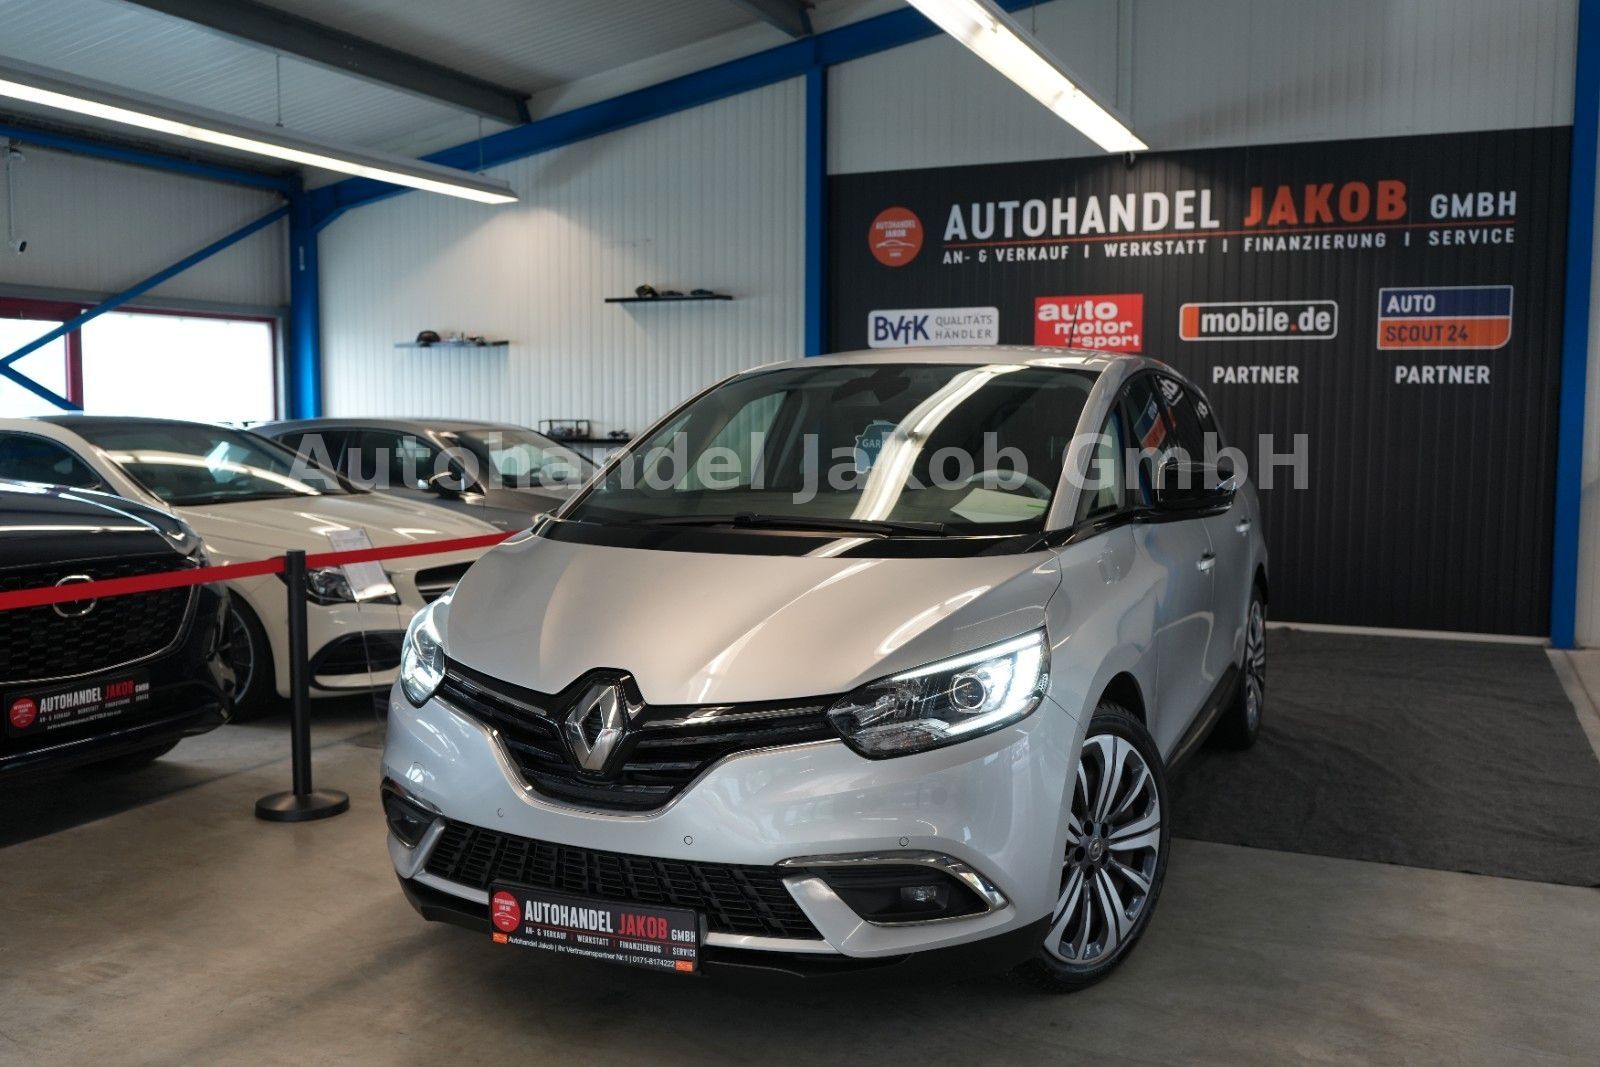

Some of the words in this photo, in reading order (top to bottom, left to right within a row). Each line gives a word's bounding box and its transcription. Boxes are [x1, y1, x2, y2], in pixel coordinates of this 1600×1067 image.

[943, 189, 1220, 241] AUTOHANDEL
[1243, 179, 1408, 227] JAKOB
[1430, 191, 1517, 219] GMBH
[943, 250, 970, 264] AN-
[978, 249, 988, 263] &
[995, 245, 1070, 262] VERKAUF
[1104, 239, 1207, 258] WERKSTATT
[1244, 232, 1387, 252] FINANZIERUNG
[1428, 228, 1515, 246] SERVICE
[1038, 300, 1118, 321] auto
[1386, 294, 1436, 313] AUTO
[1054, 320, 1133, 335] motor
[1201, 306, 1331, 333] mobile.de
[1081, 334, 1140, 348] sport
[1386, 325, 1442, 342] SCOUT
[1447, 325, 1469, 341] 24
[1212, 365, 1300, 384] PARTNER
[1395, 365, 1491, 384] PARTNER
[39, 687, 102, 714] AUTOHANDEL
[524, 900, 614, 933] AUTOHANDEL
[618, 912, 668, 940] JAKOB
[671, 928, 696, 943] GMBH
[508, 936, 538, 948] Autohandel
[543, 929, 567, 940] VERKAUF
[577, 934, 609, 946] WERKSTATT
[620, 940, 662, 954] FINANZIERUNG
